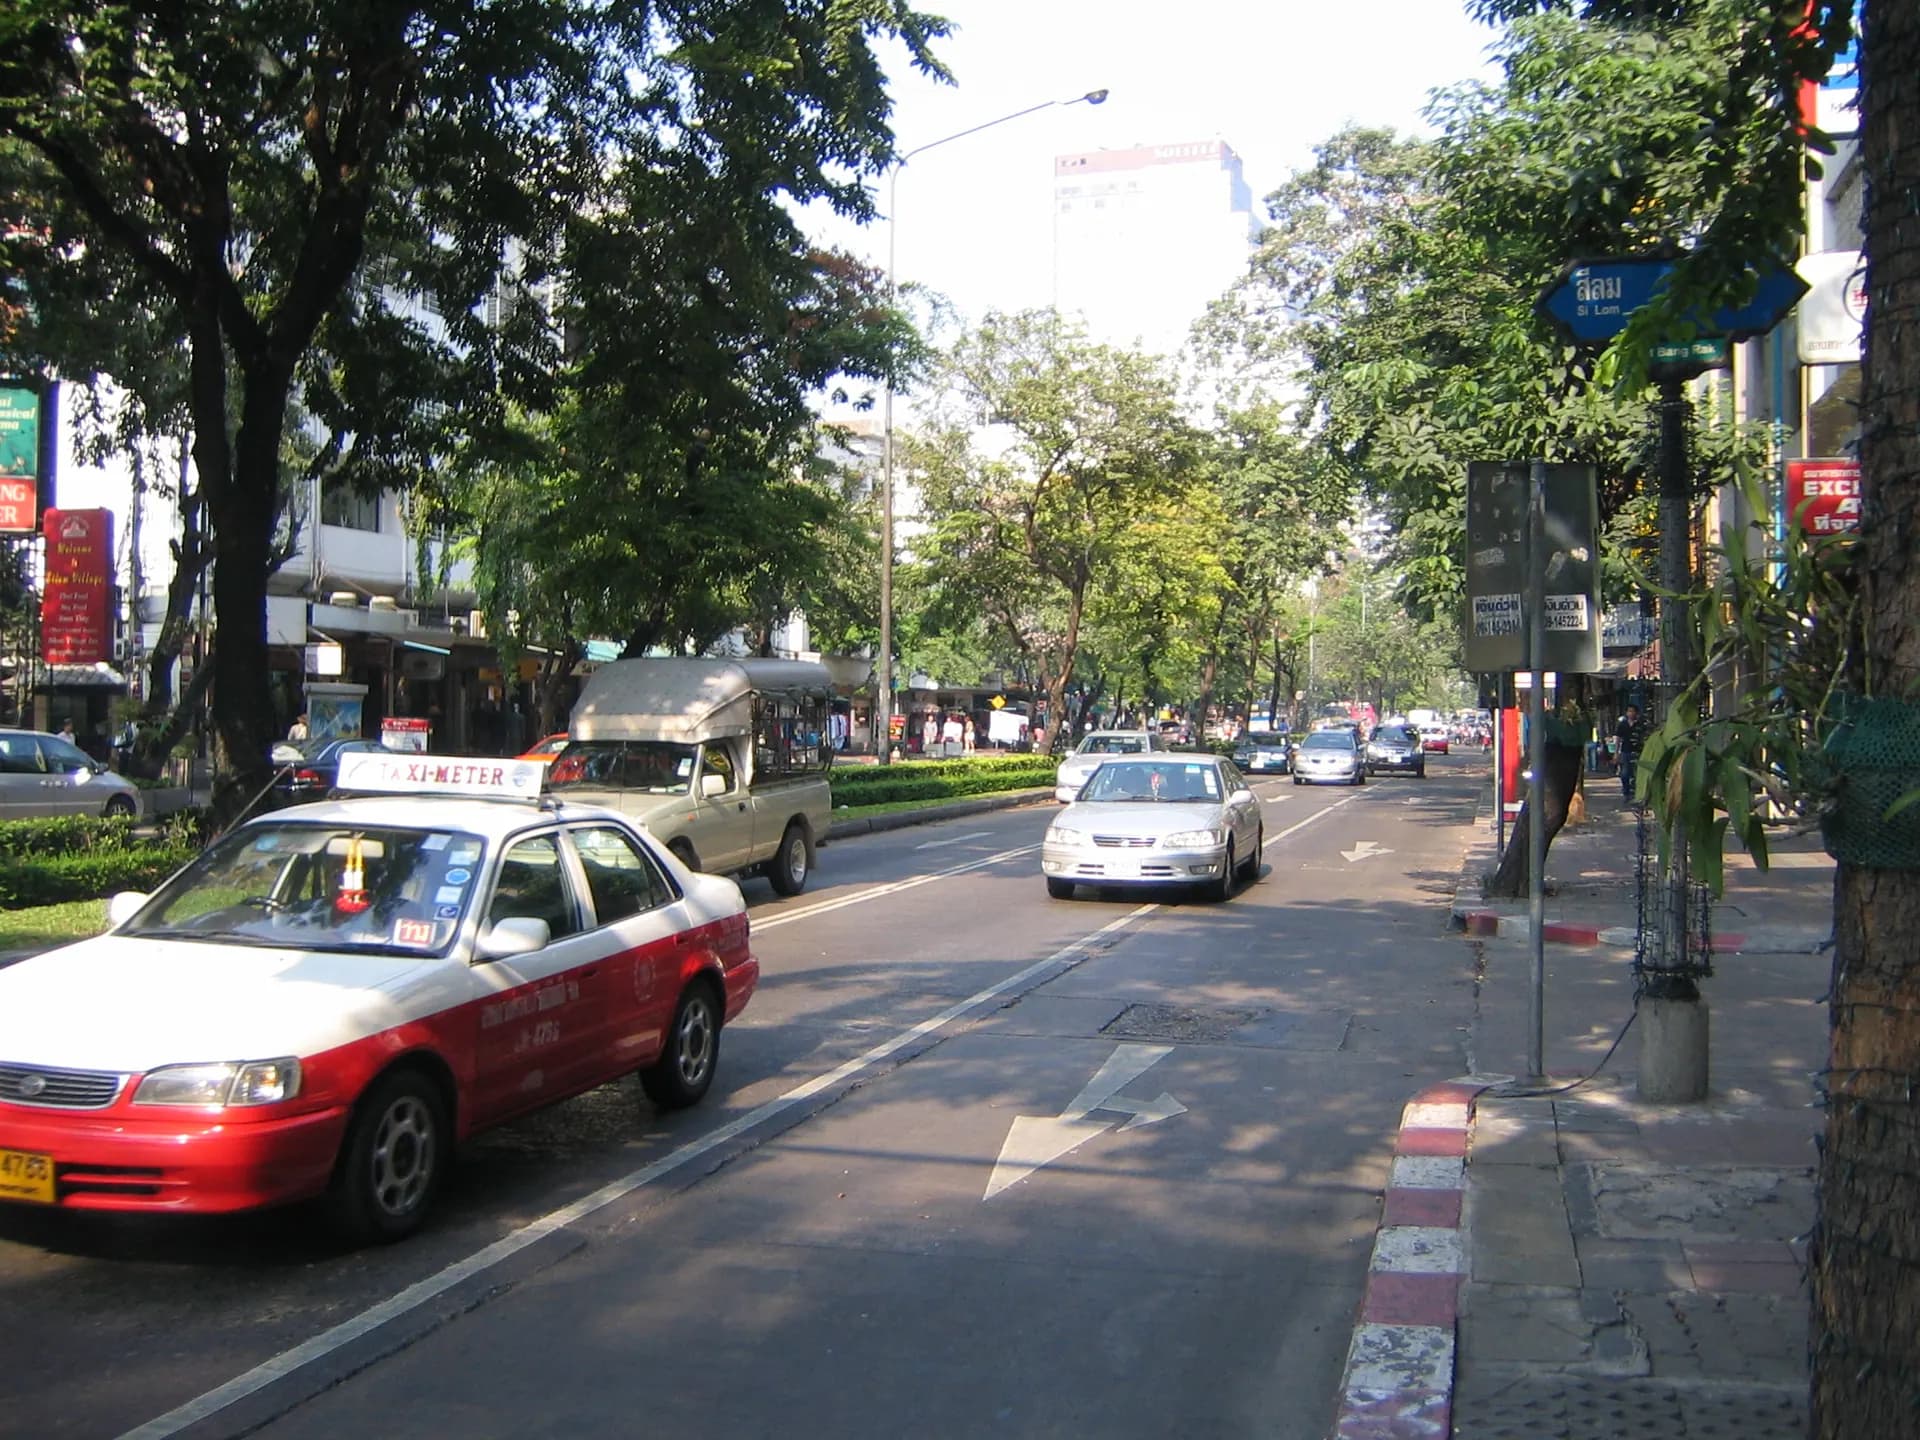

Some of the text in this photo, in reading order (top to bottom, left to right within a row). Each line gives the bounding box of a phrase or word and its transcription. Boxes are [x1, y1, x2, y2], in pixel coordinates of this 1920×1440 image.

[1576, 305, 1620, 316] Si Lom
[1657, 346, 1689, 358] Bang
[1692, 344, 1716, 356] Rak
